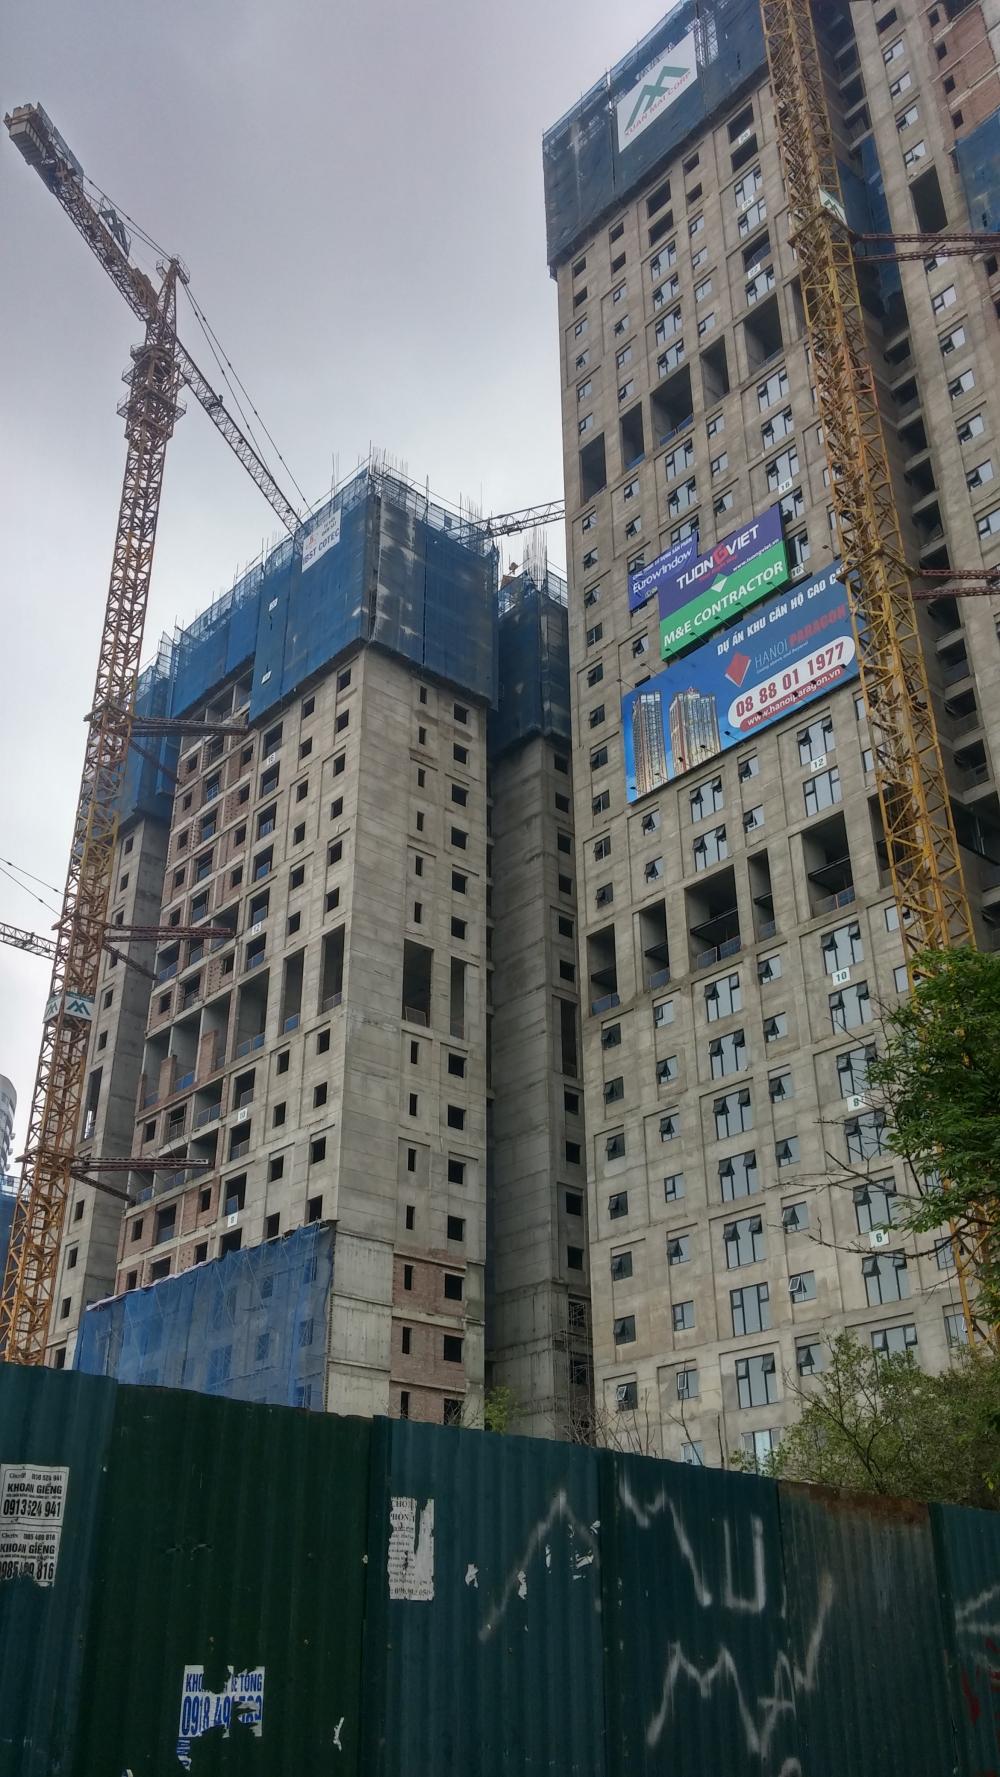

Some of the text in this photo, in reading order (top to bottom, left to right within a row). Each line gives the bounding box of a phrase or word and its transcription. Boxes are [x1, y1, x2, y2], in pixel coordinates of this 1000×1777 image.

[664, 620, 692, 647] M&E
[694, 560, 784, 626] CONTRACTOR
[732, 629, 745, 646] ÁN
[746, 618, 767, 637] KHU
[790, 592, 804, 611] HỘ
[807, 579, 826, 599] CAO
[754, 638, 788, 669] HANOI
[788, 603, 846, 648] PARAGON
[735, 695, 754, 718] 08
[759, 681, 777, 704] 88
[782, 668, 800, 691] 01
[807, 641, 844, 676] 1977
[812, 757, 825, 771] 12
[835, 970, 848, 984] 10
[875, 1231, 884, 1244] 6
[7, 1482, 35, 1493] KHOAN
[44, 1500, 61, 1518] 941
[181, 1696, 211, 1736] 0918
